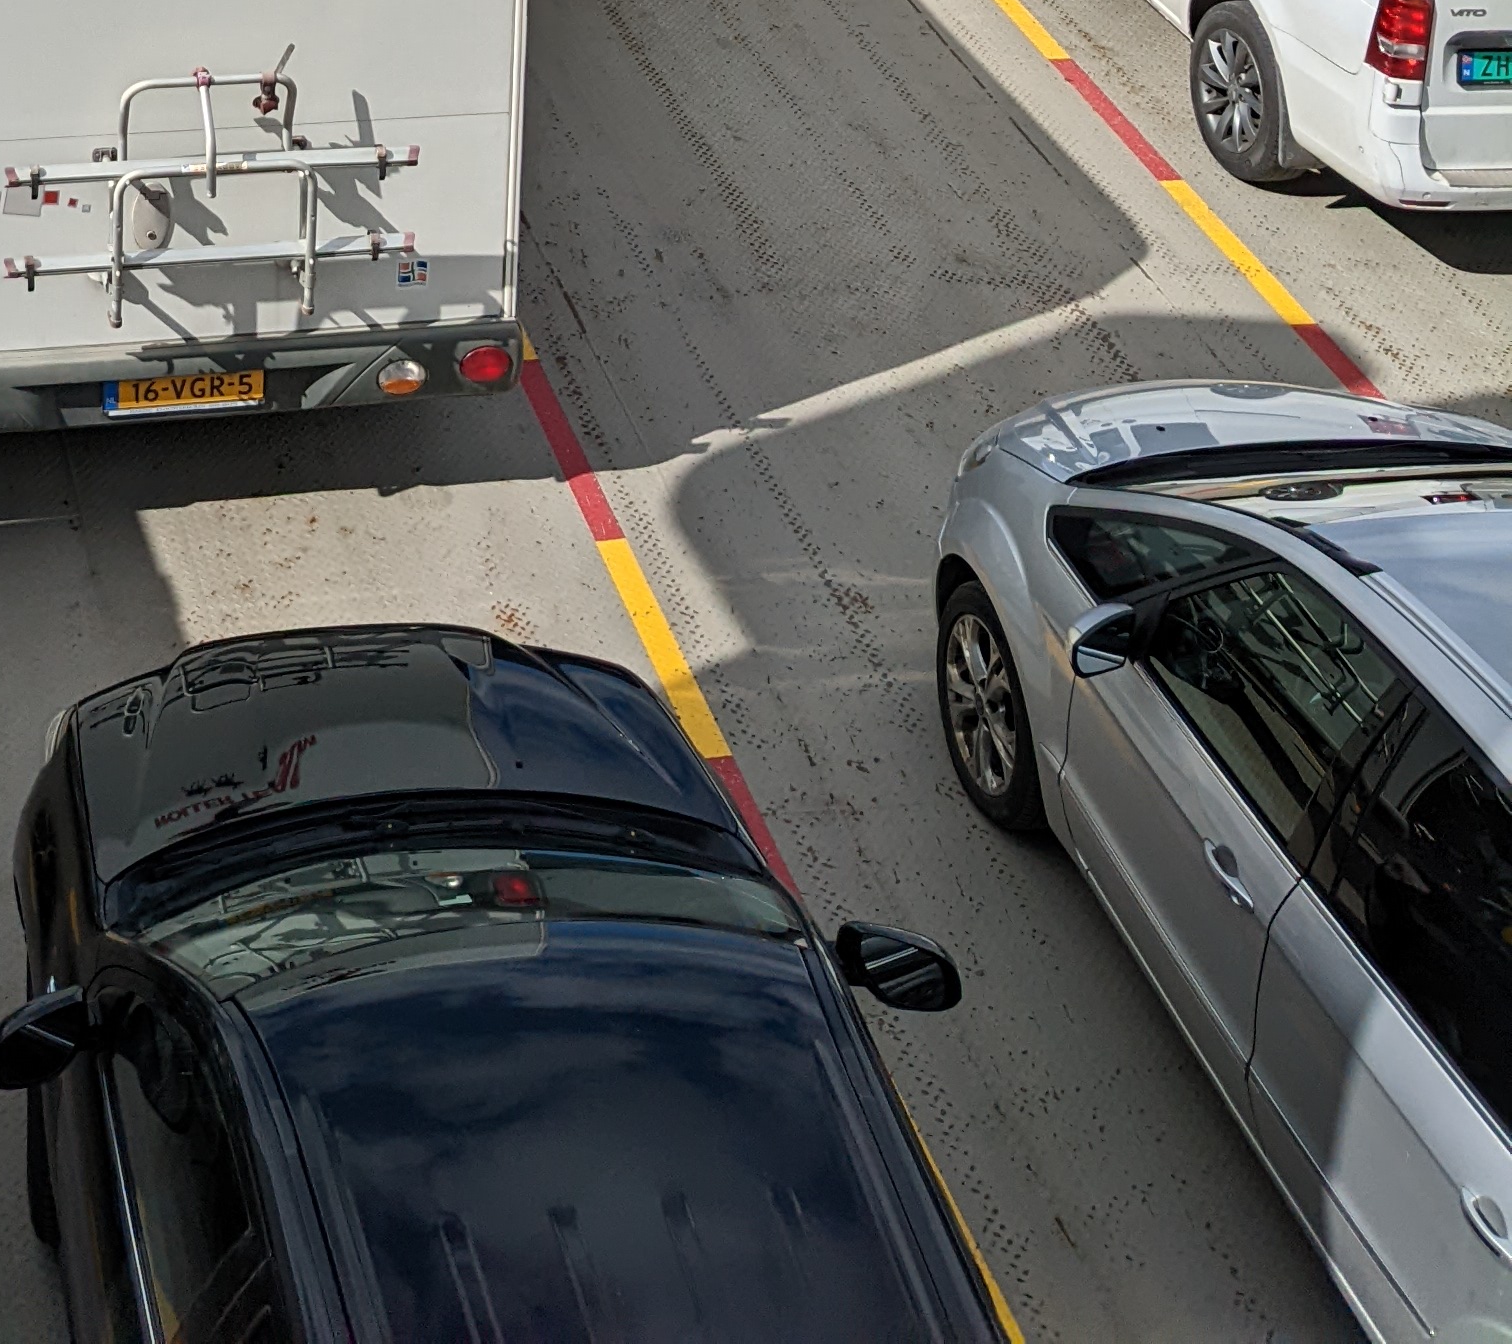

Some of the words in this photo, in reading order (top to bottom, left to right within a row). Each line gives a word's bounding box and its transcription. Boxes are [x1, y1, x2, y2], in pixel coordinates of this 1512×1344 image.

[1450, 8, 1487, 17] VITO
[1481, 55, 1509, 77] ZH
[132, 374, 253, 403] 16-VGR-5
